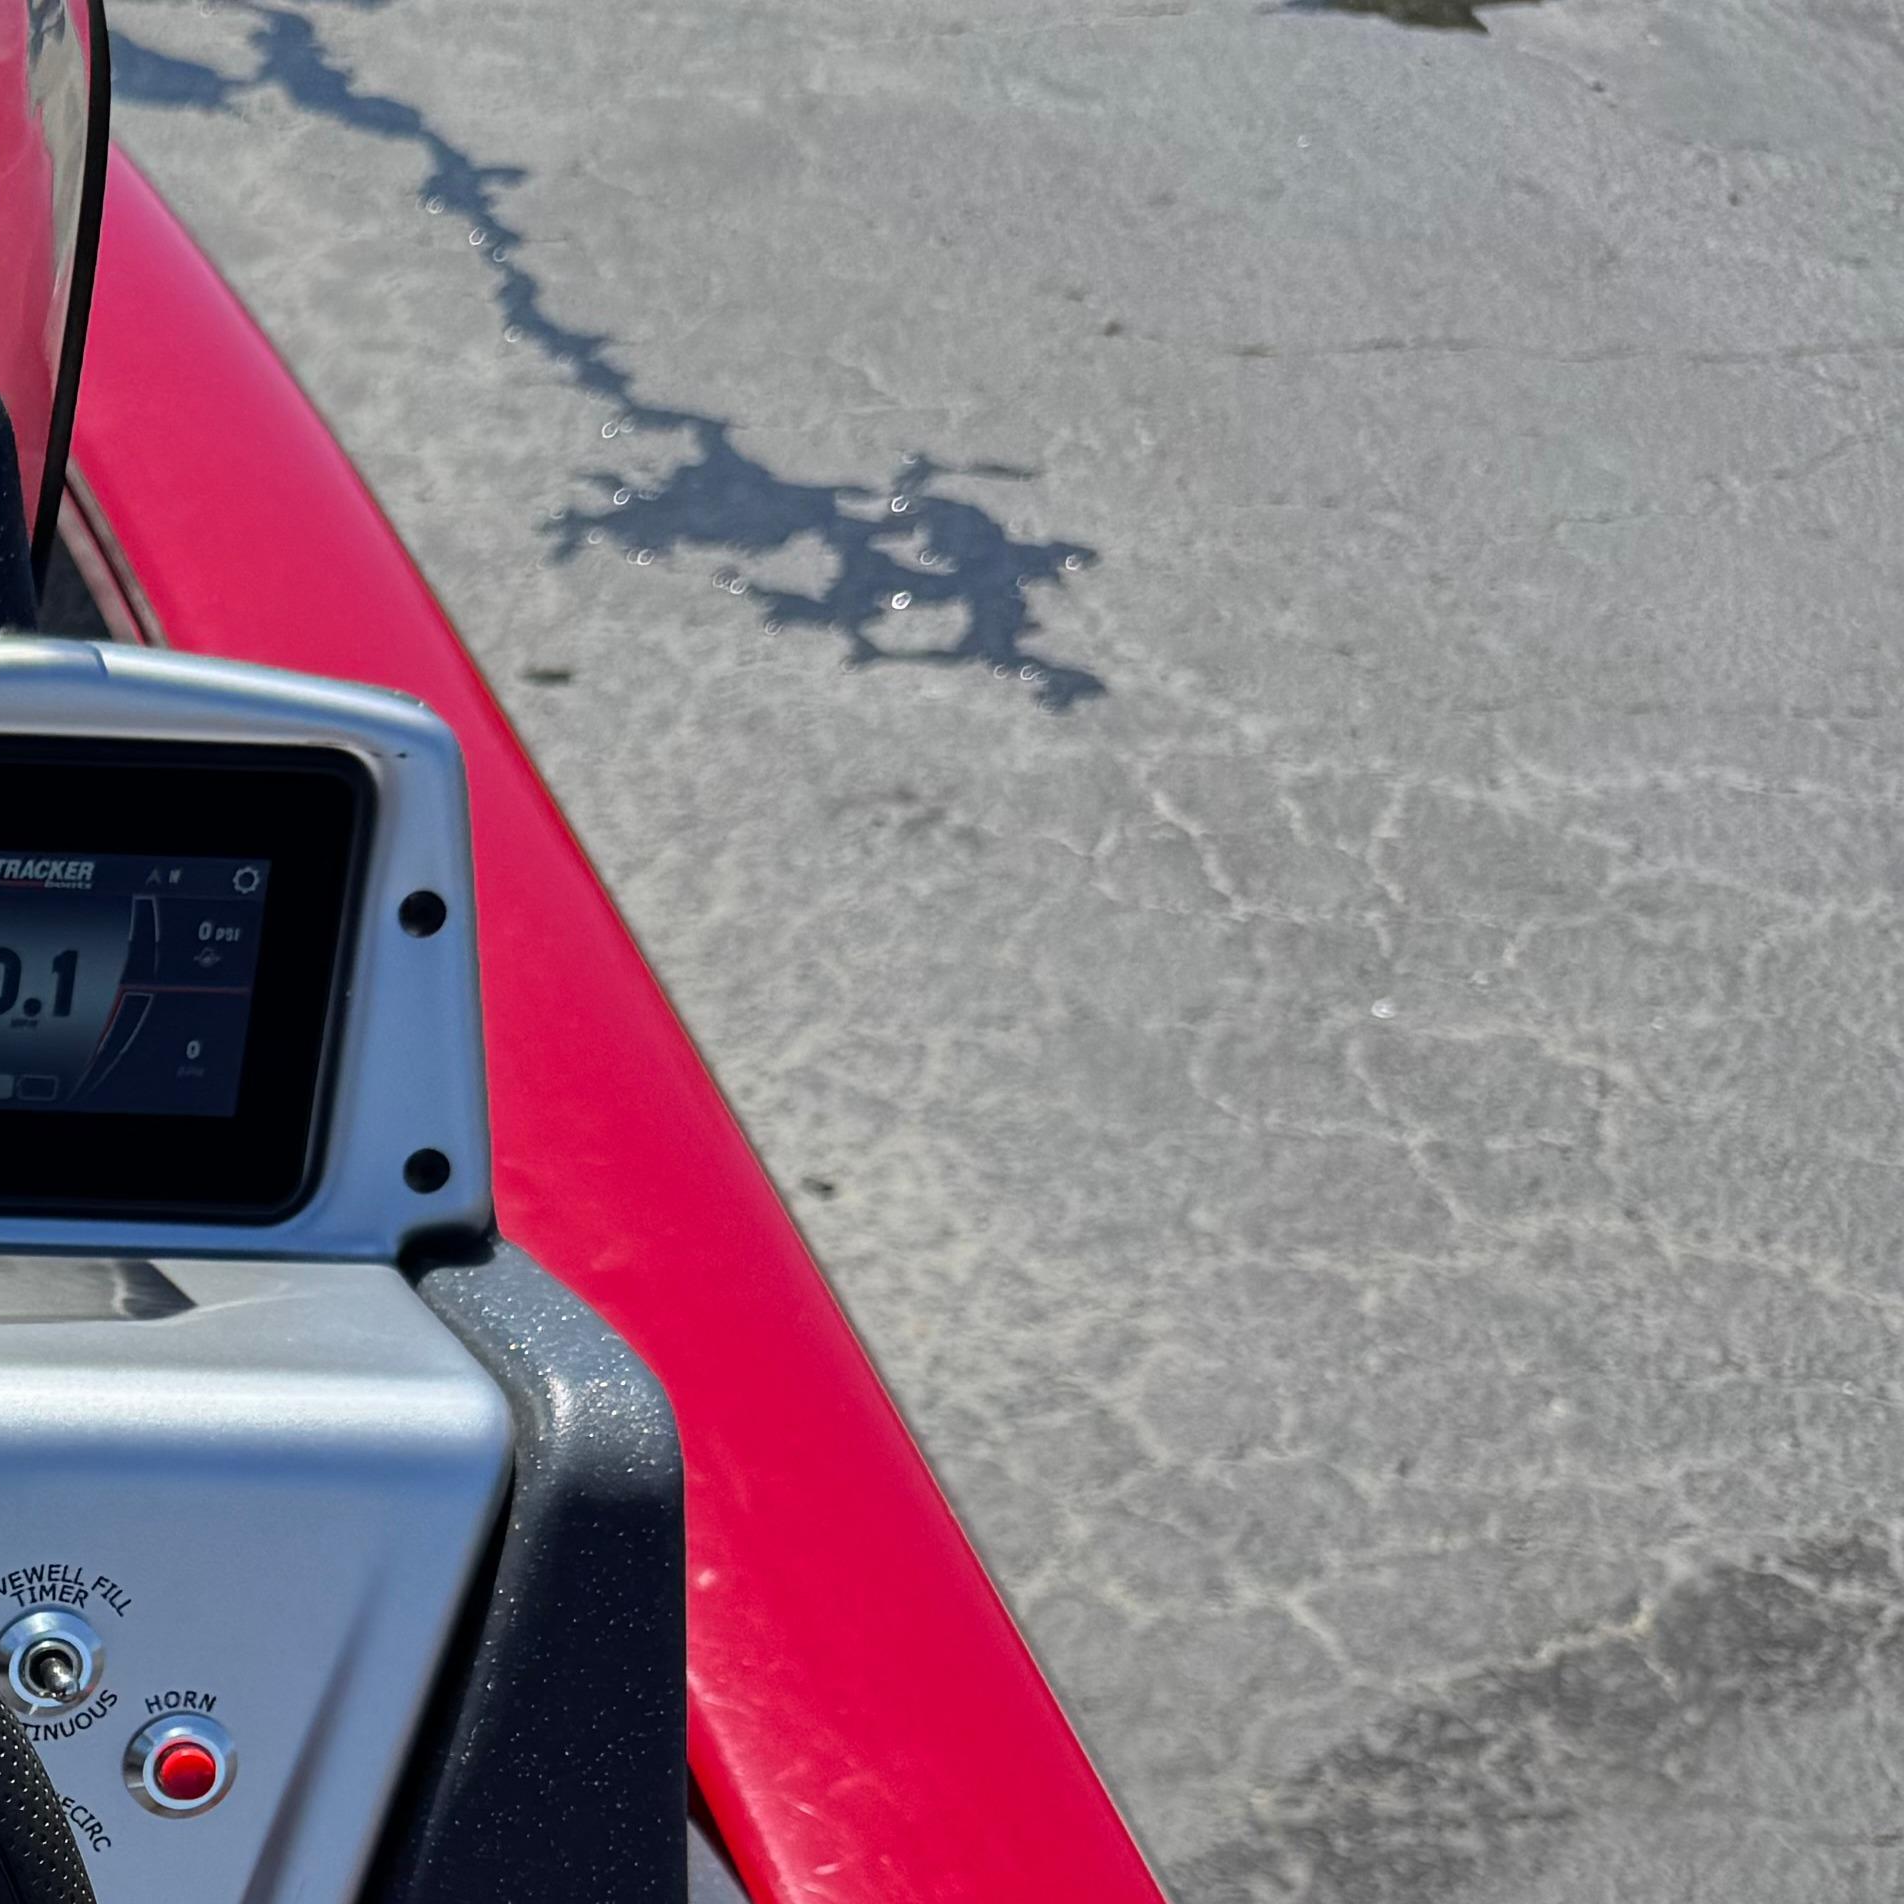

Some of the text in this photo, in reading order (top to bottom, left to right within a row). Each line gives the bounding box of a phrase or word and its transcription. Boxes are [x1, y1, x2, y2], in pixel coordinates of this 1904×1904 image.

[197, 920, 213, 942] 0
[9, 1583, 89, 1610] TIMER
[90, 1575, 132, 1618] FILL
[21, 1688, 119, 1742] TINUOUS
[144, 1690, 217, 1715] HORN
[55, 1793, 112, 1853] ECIRC
